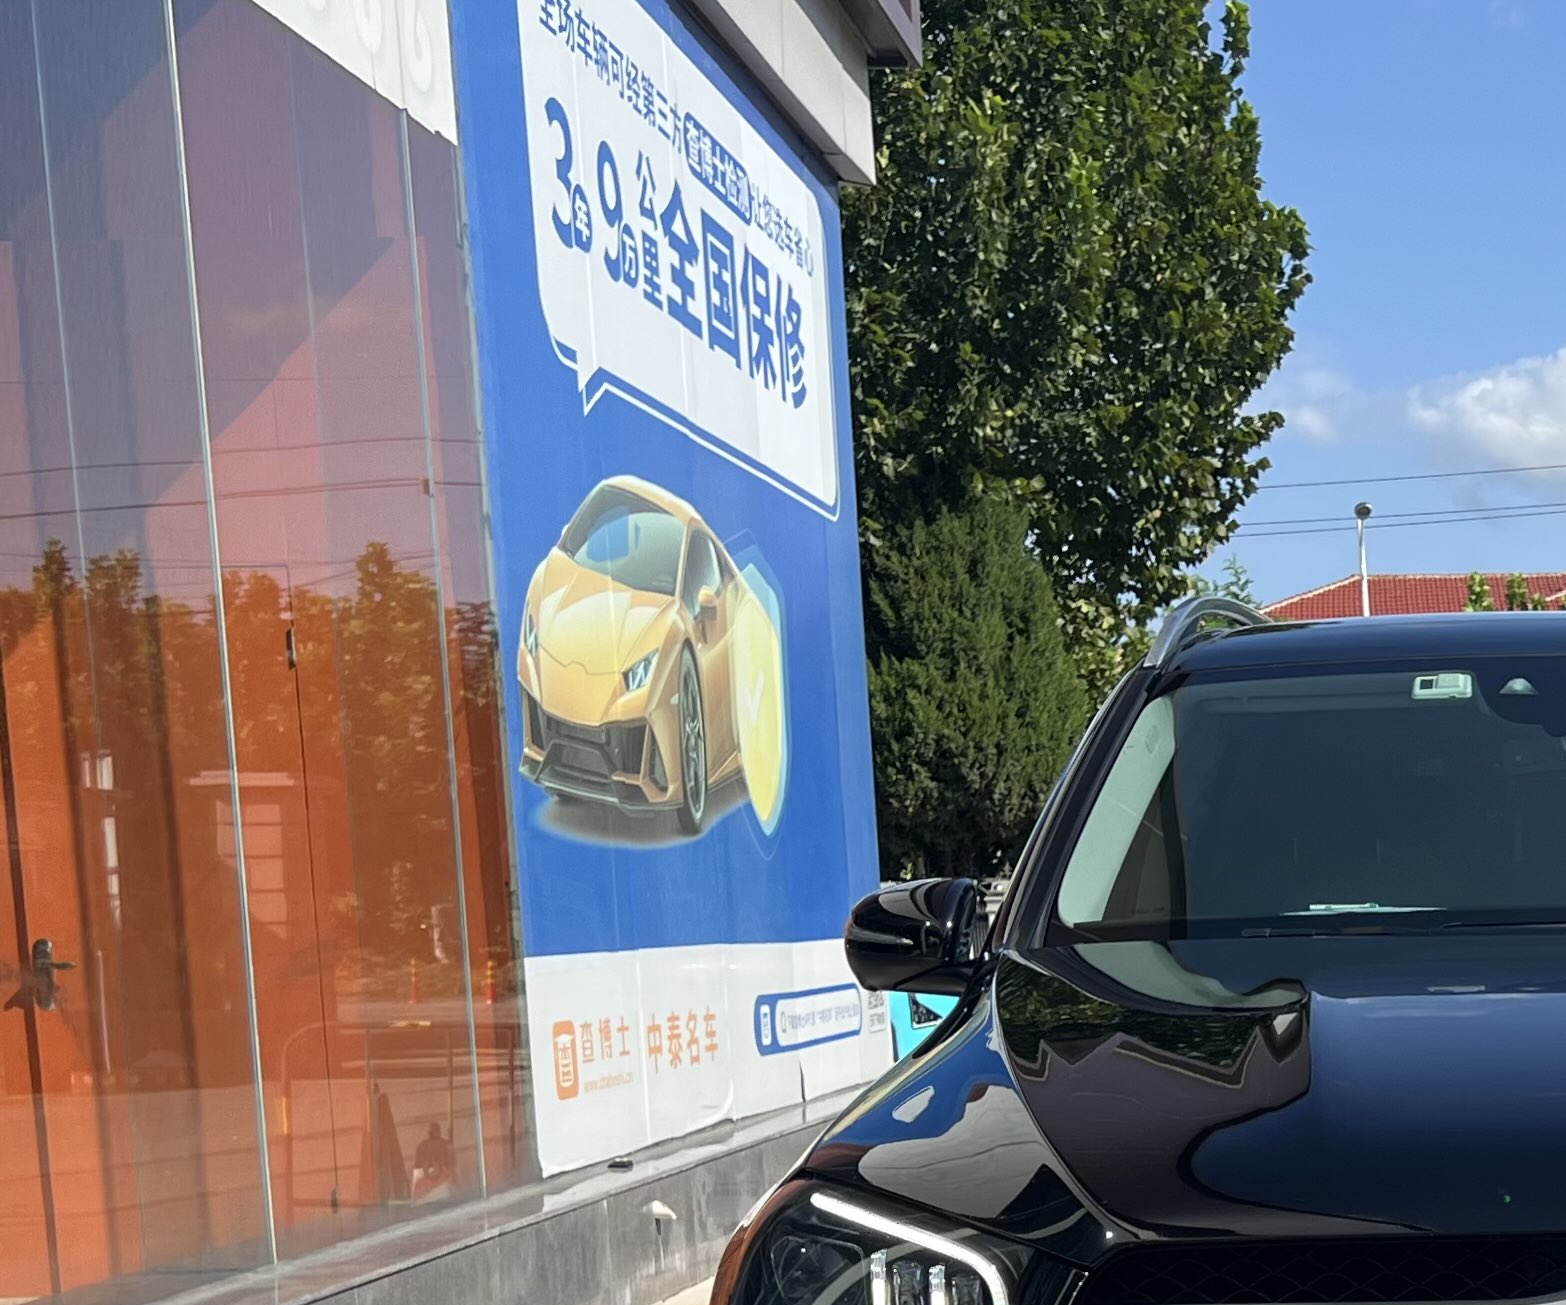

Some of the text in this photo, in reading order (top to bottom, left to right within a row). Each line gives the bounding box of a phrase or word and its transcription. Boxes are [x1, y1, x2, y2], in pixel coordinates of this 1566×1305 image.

[580, 1016, 631, 1063] 查博士
[647, 1005, 718, 1074] 中泰名车
